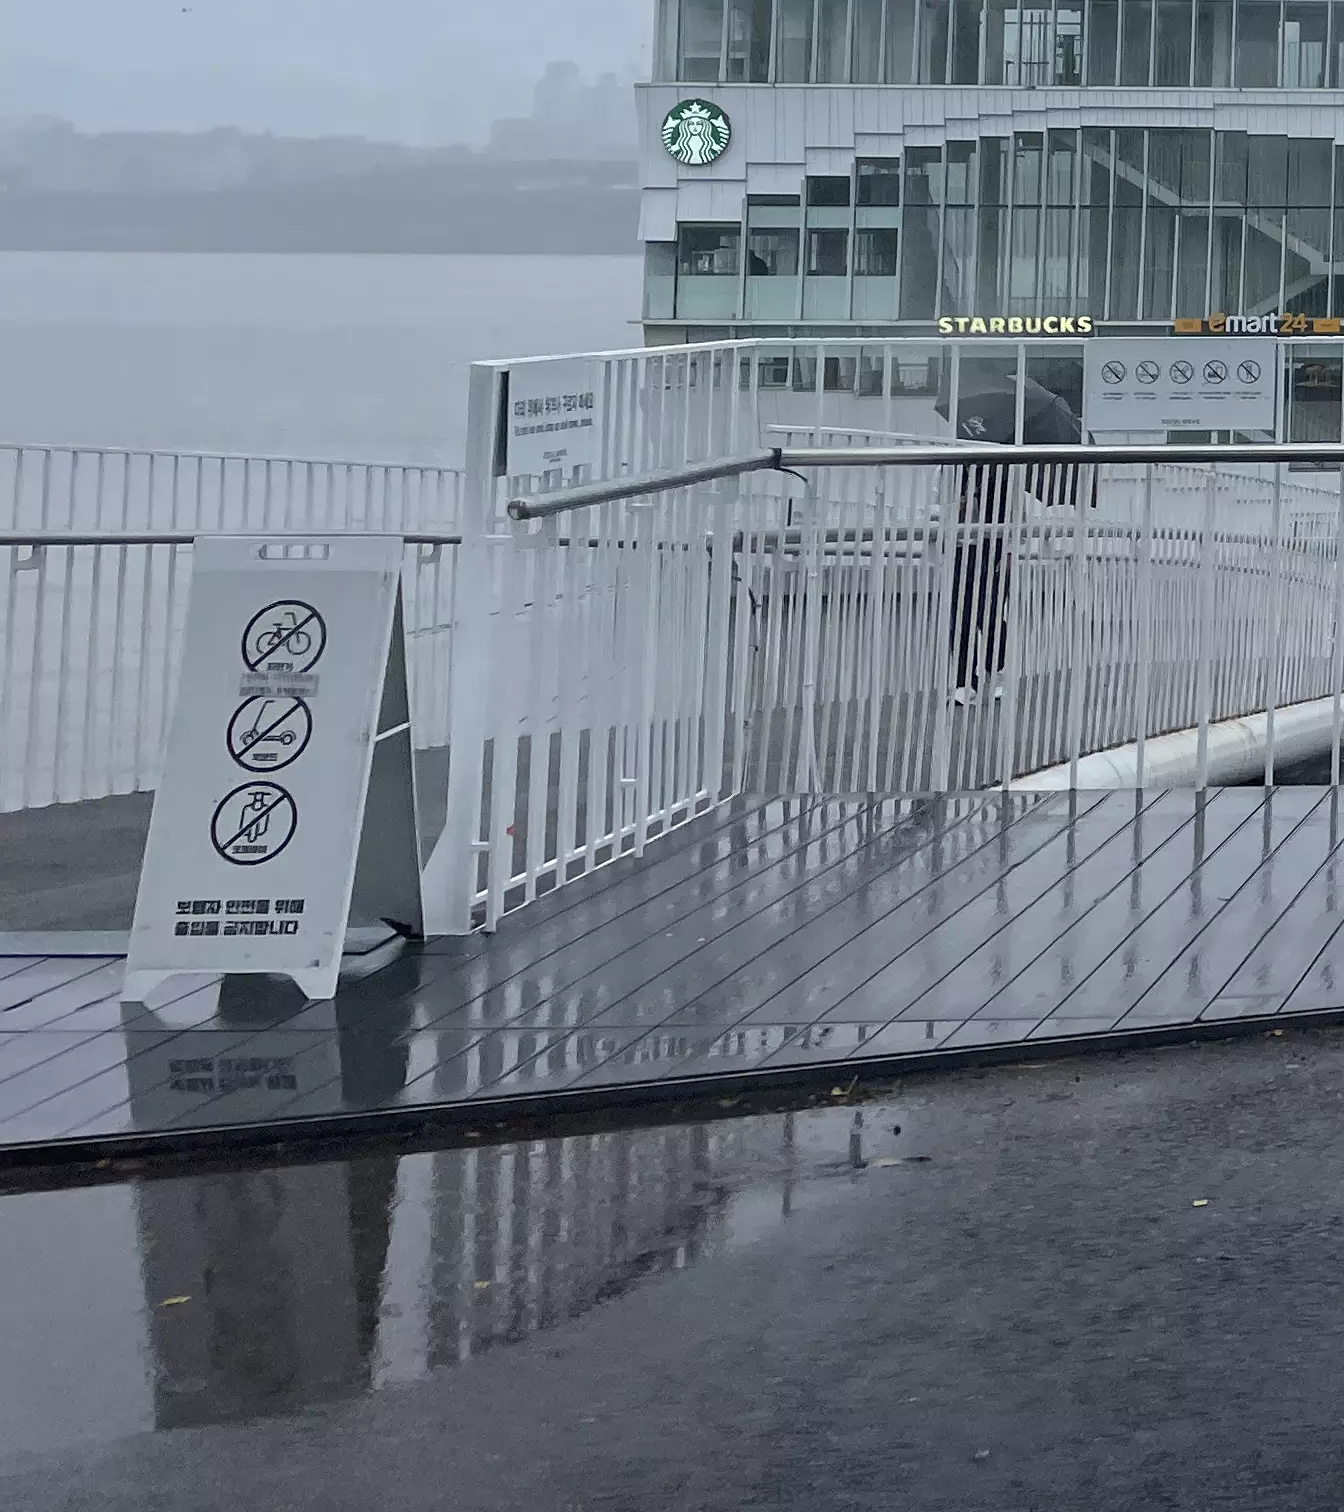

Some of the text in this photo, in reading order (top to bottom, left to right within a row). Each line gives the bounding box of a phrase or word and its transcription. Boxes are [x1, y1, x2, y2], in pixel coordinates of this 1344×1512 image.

[937, 315, 1093, 335] STARBUCKS
[225, 899, 271, 915] 안전
[174, 920, 220, 937] 출입
